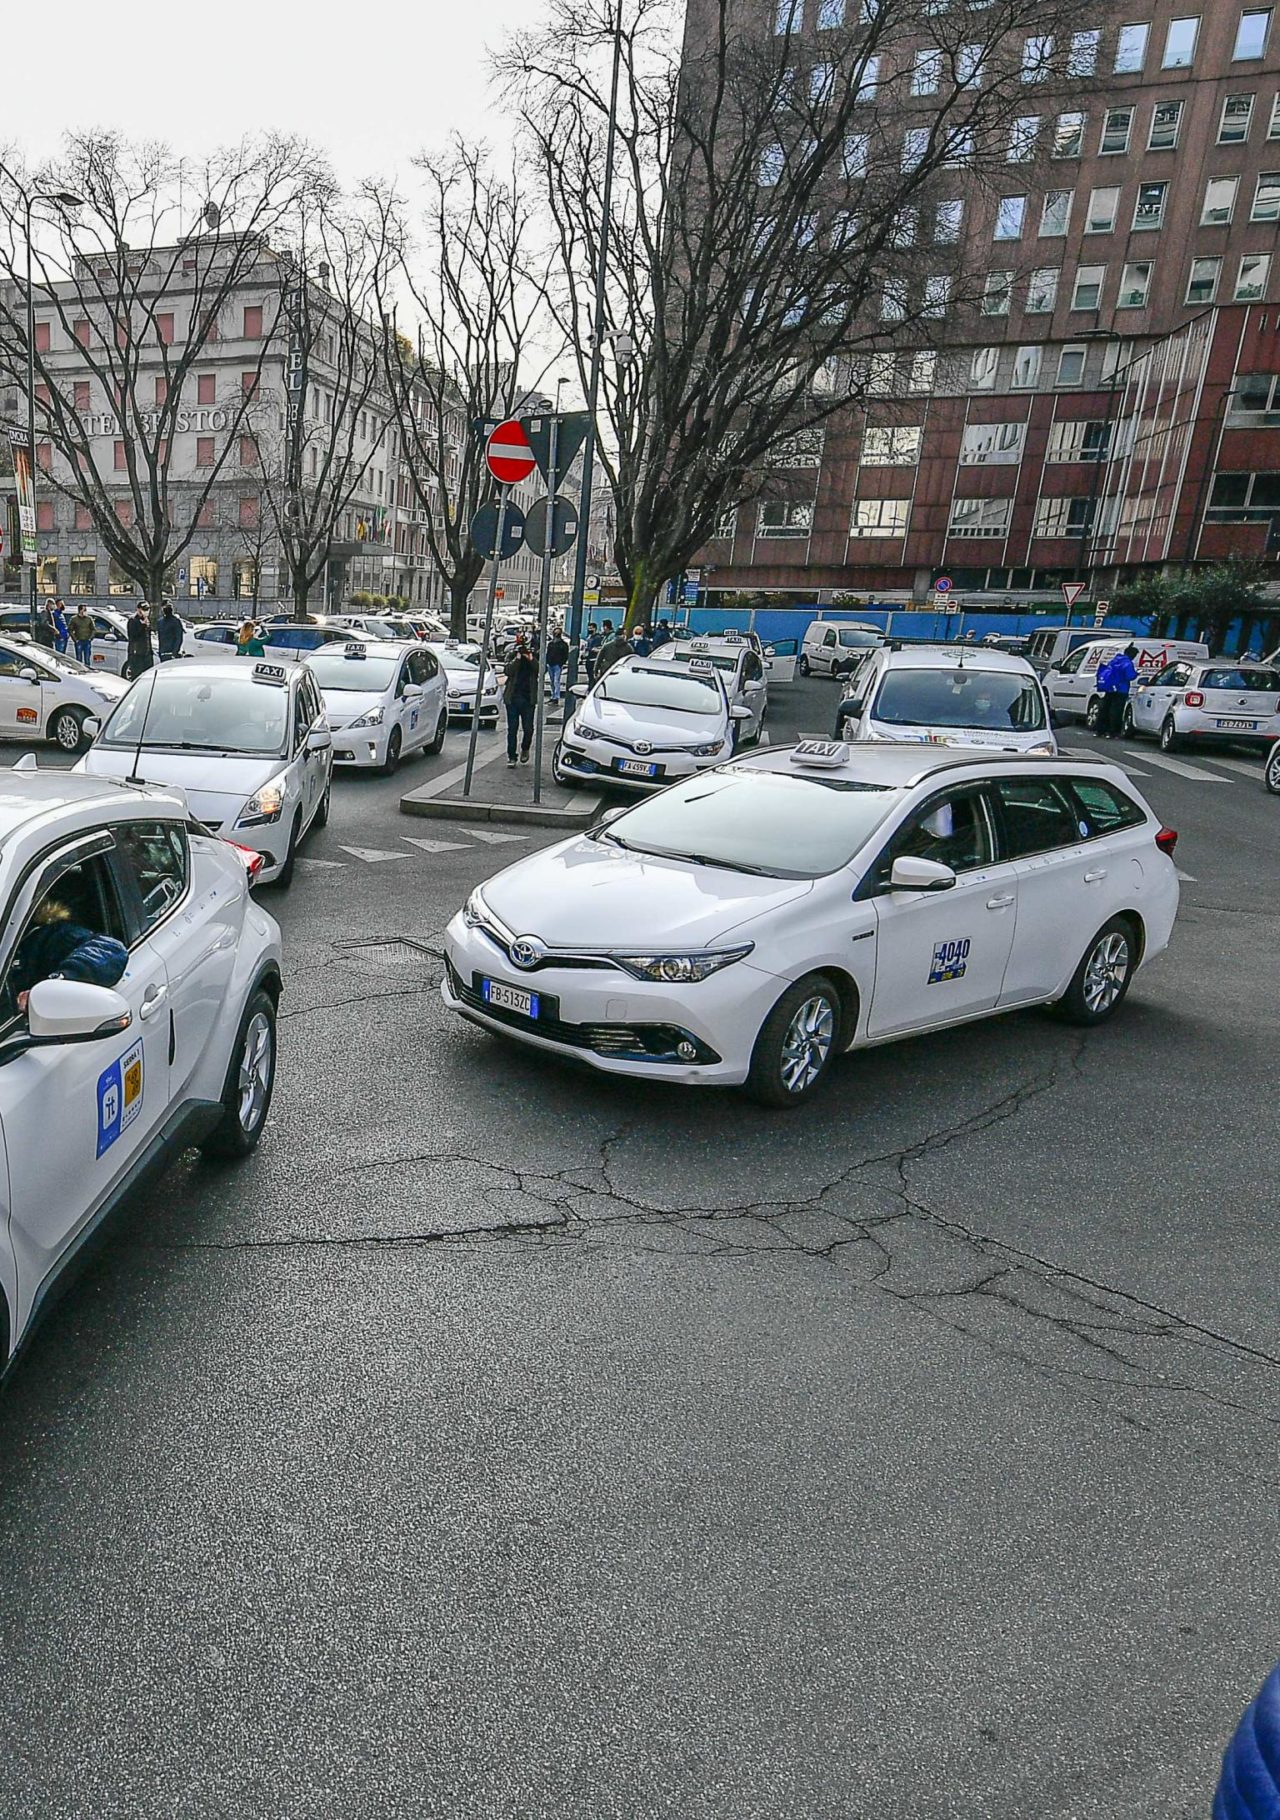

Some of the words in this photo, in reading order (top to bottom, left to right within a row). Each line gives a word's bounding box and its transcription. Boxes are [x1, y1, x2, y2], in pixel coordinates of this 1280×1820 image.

[346, 643, 365, 651] TAXI
[257, 664, 284, 677] TAXI
[803, 742, 841, 756] TAXI
[939, 939, 971, 967] 4040
